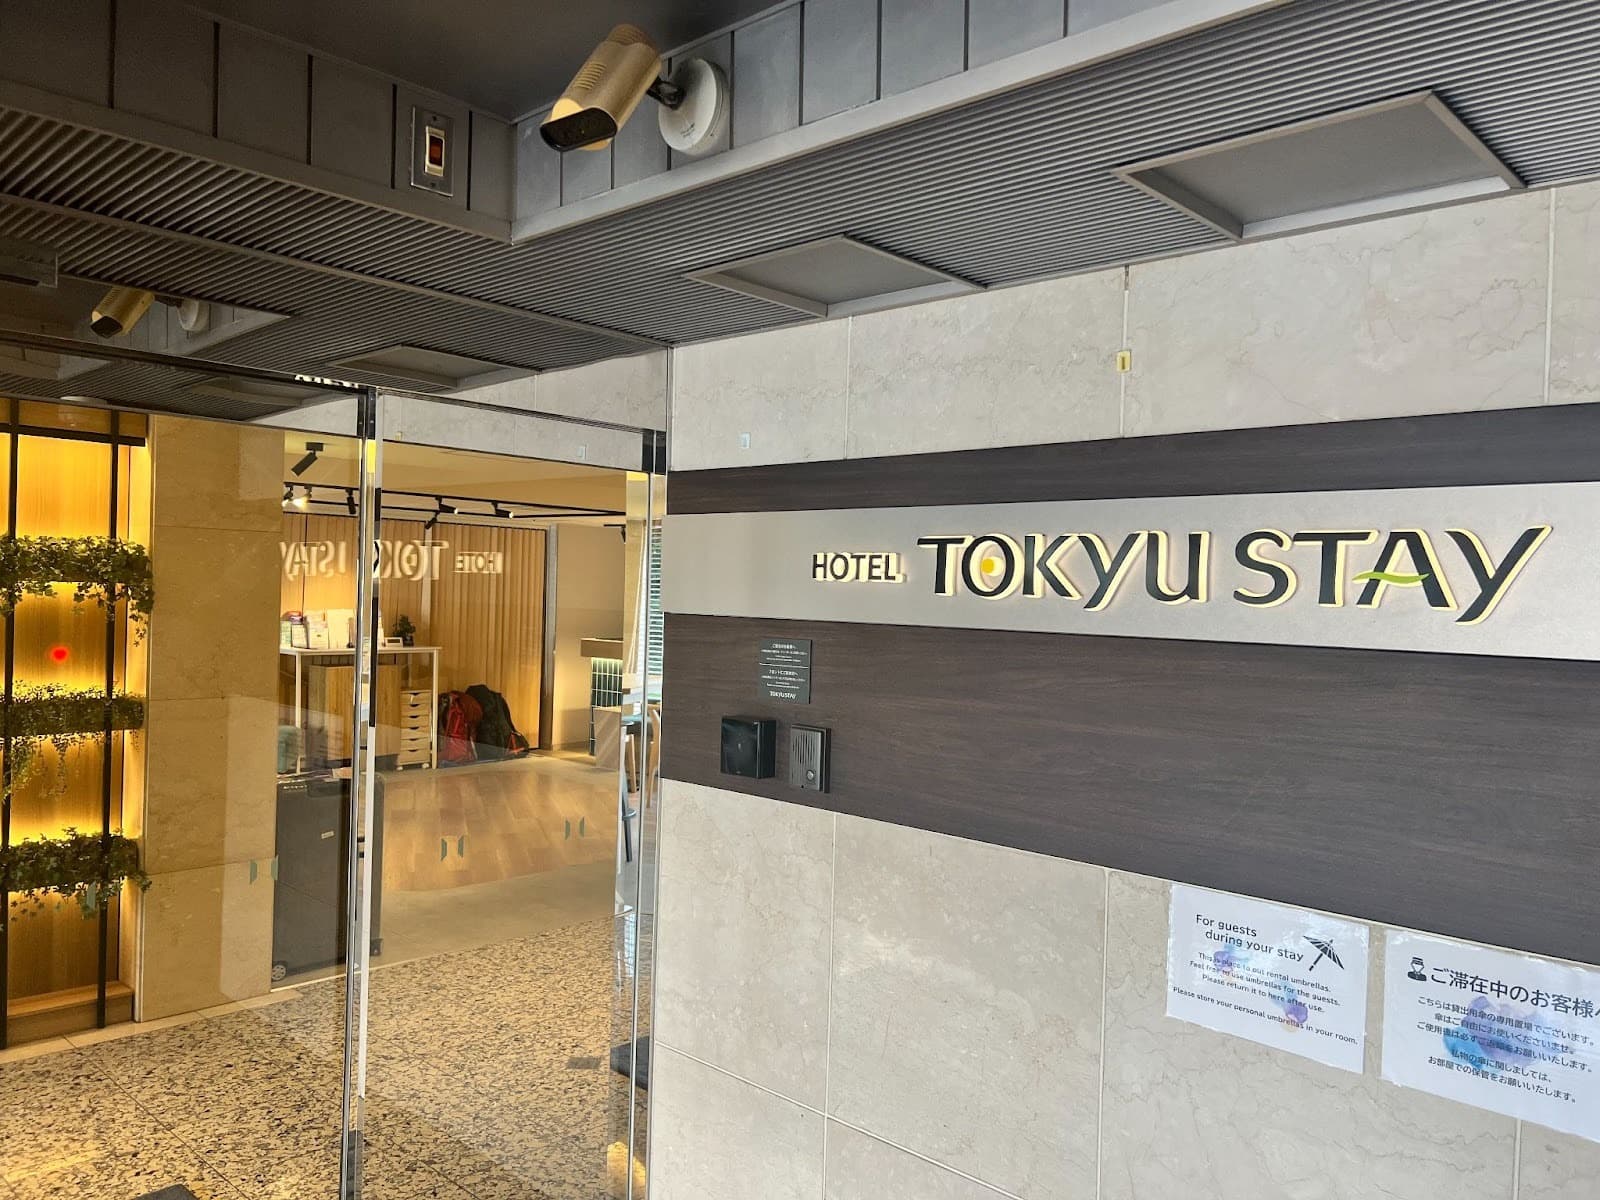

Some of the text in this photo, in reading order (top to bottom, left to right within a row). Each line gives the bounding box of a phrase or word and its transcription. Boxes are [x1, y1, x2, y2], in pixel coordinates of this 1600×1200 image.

[812, 527, 1550, 624] HOTEL TOKYU STAY
[1196, 914, 1257, 937] For guests
[1205, 930, 1304, 962] during your stay
[1199, 952, 1212, 962] This
[1267, 971, 1289, 982] rental
[1290, 977, 1331, 993] umbrellas.
[1231, 972, 1244, 981] use
[1246, 976, 1282, 991] umbrellas
[1284, 985, 1294, 994] for
[1297, 988, 1310, 998] the
[1312, 993, 1341, 1007] guests.
[1202, 974, 1225, 986] Please
[1226, 981, 1249, 993] return
[1258, 990, 1267, 998] to
[1268, 992, 1285, 1002] here
[1287, 997, 1306, 1009] after
[1173, 986, 1195, 998] Please
[1196, 993, 1215, 1004] store
[1216, 999, 1233, 1009] your
[1234, 1004, 1266, 1018] personal
[1267, 1013, 1304, 1029] umbrellas
[1315, 1027, 1333, 1037] your
[1335, 1032, 1358, 1045] room.
